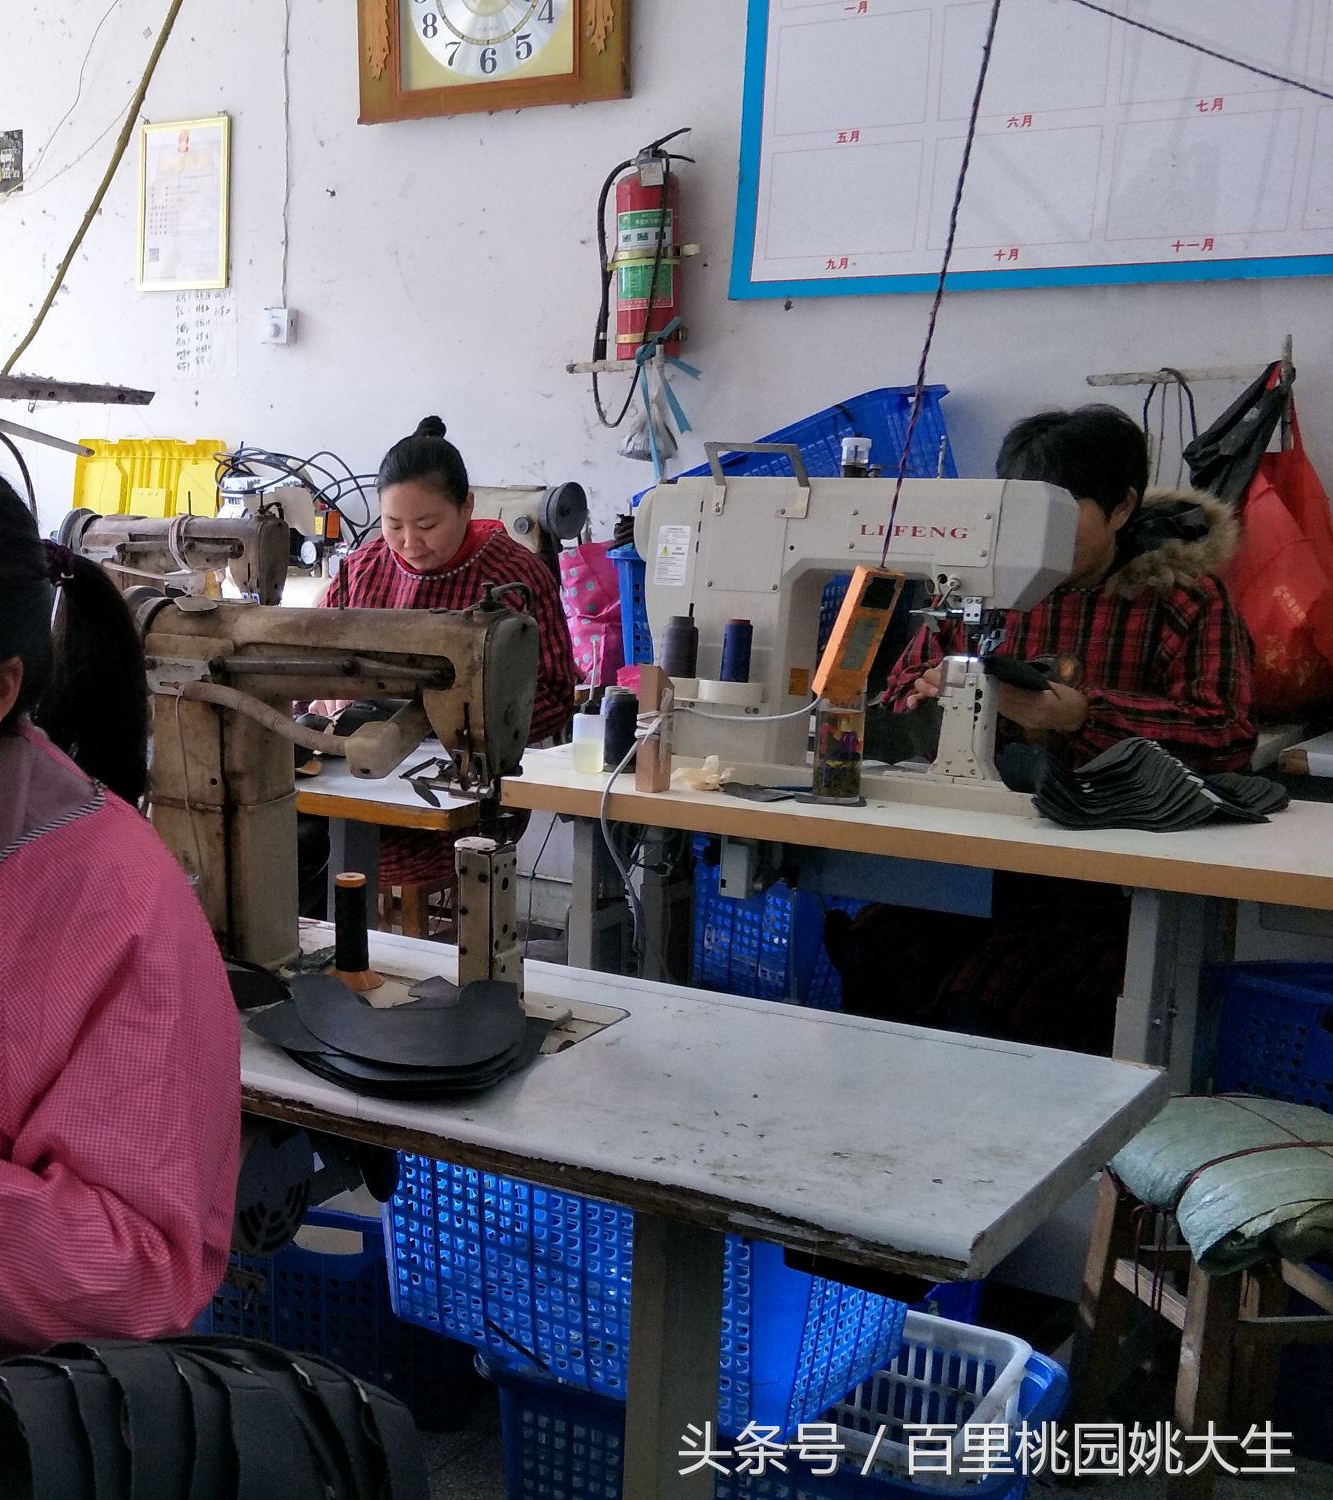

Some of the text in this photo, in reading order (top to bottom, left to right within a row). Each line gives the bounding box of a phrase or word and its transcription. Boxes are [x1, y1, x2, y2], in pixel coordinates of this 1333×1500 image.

[538, 0, 555, 24] 4
[844, 0, 867, 13] 一月
[422, 12, 438, 38] 8
[445, 41, 462, 67] 7
[515, 33, 533, 60] 5
[479, 47, 498, 74] 6
[1195, 97, 1223, 112] 七月
[1006, 114, 1032, 128] 六月
[836, 130, 860, 143] 五月
[1171, 238, 1214, 252] 十一月
[993, 248, 1019, 261] 十月
[825, 257, 849, 270] 九月
[860, 524, 968, 539] LIFENG
